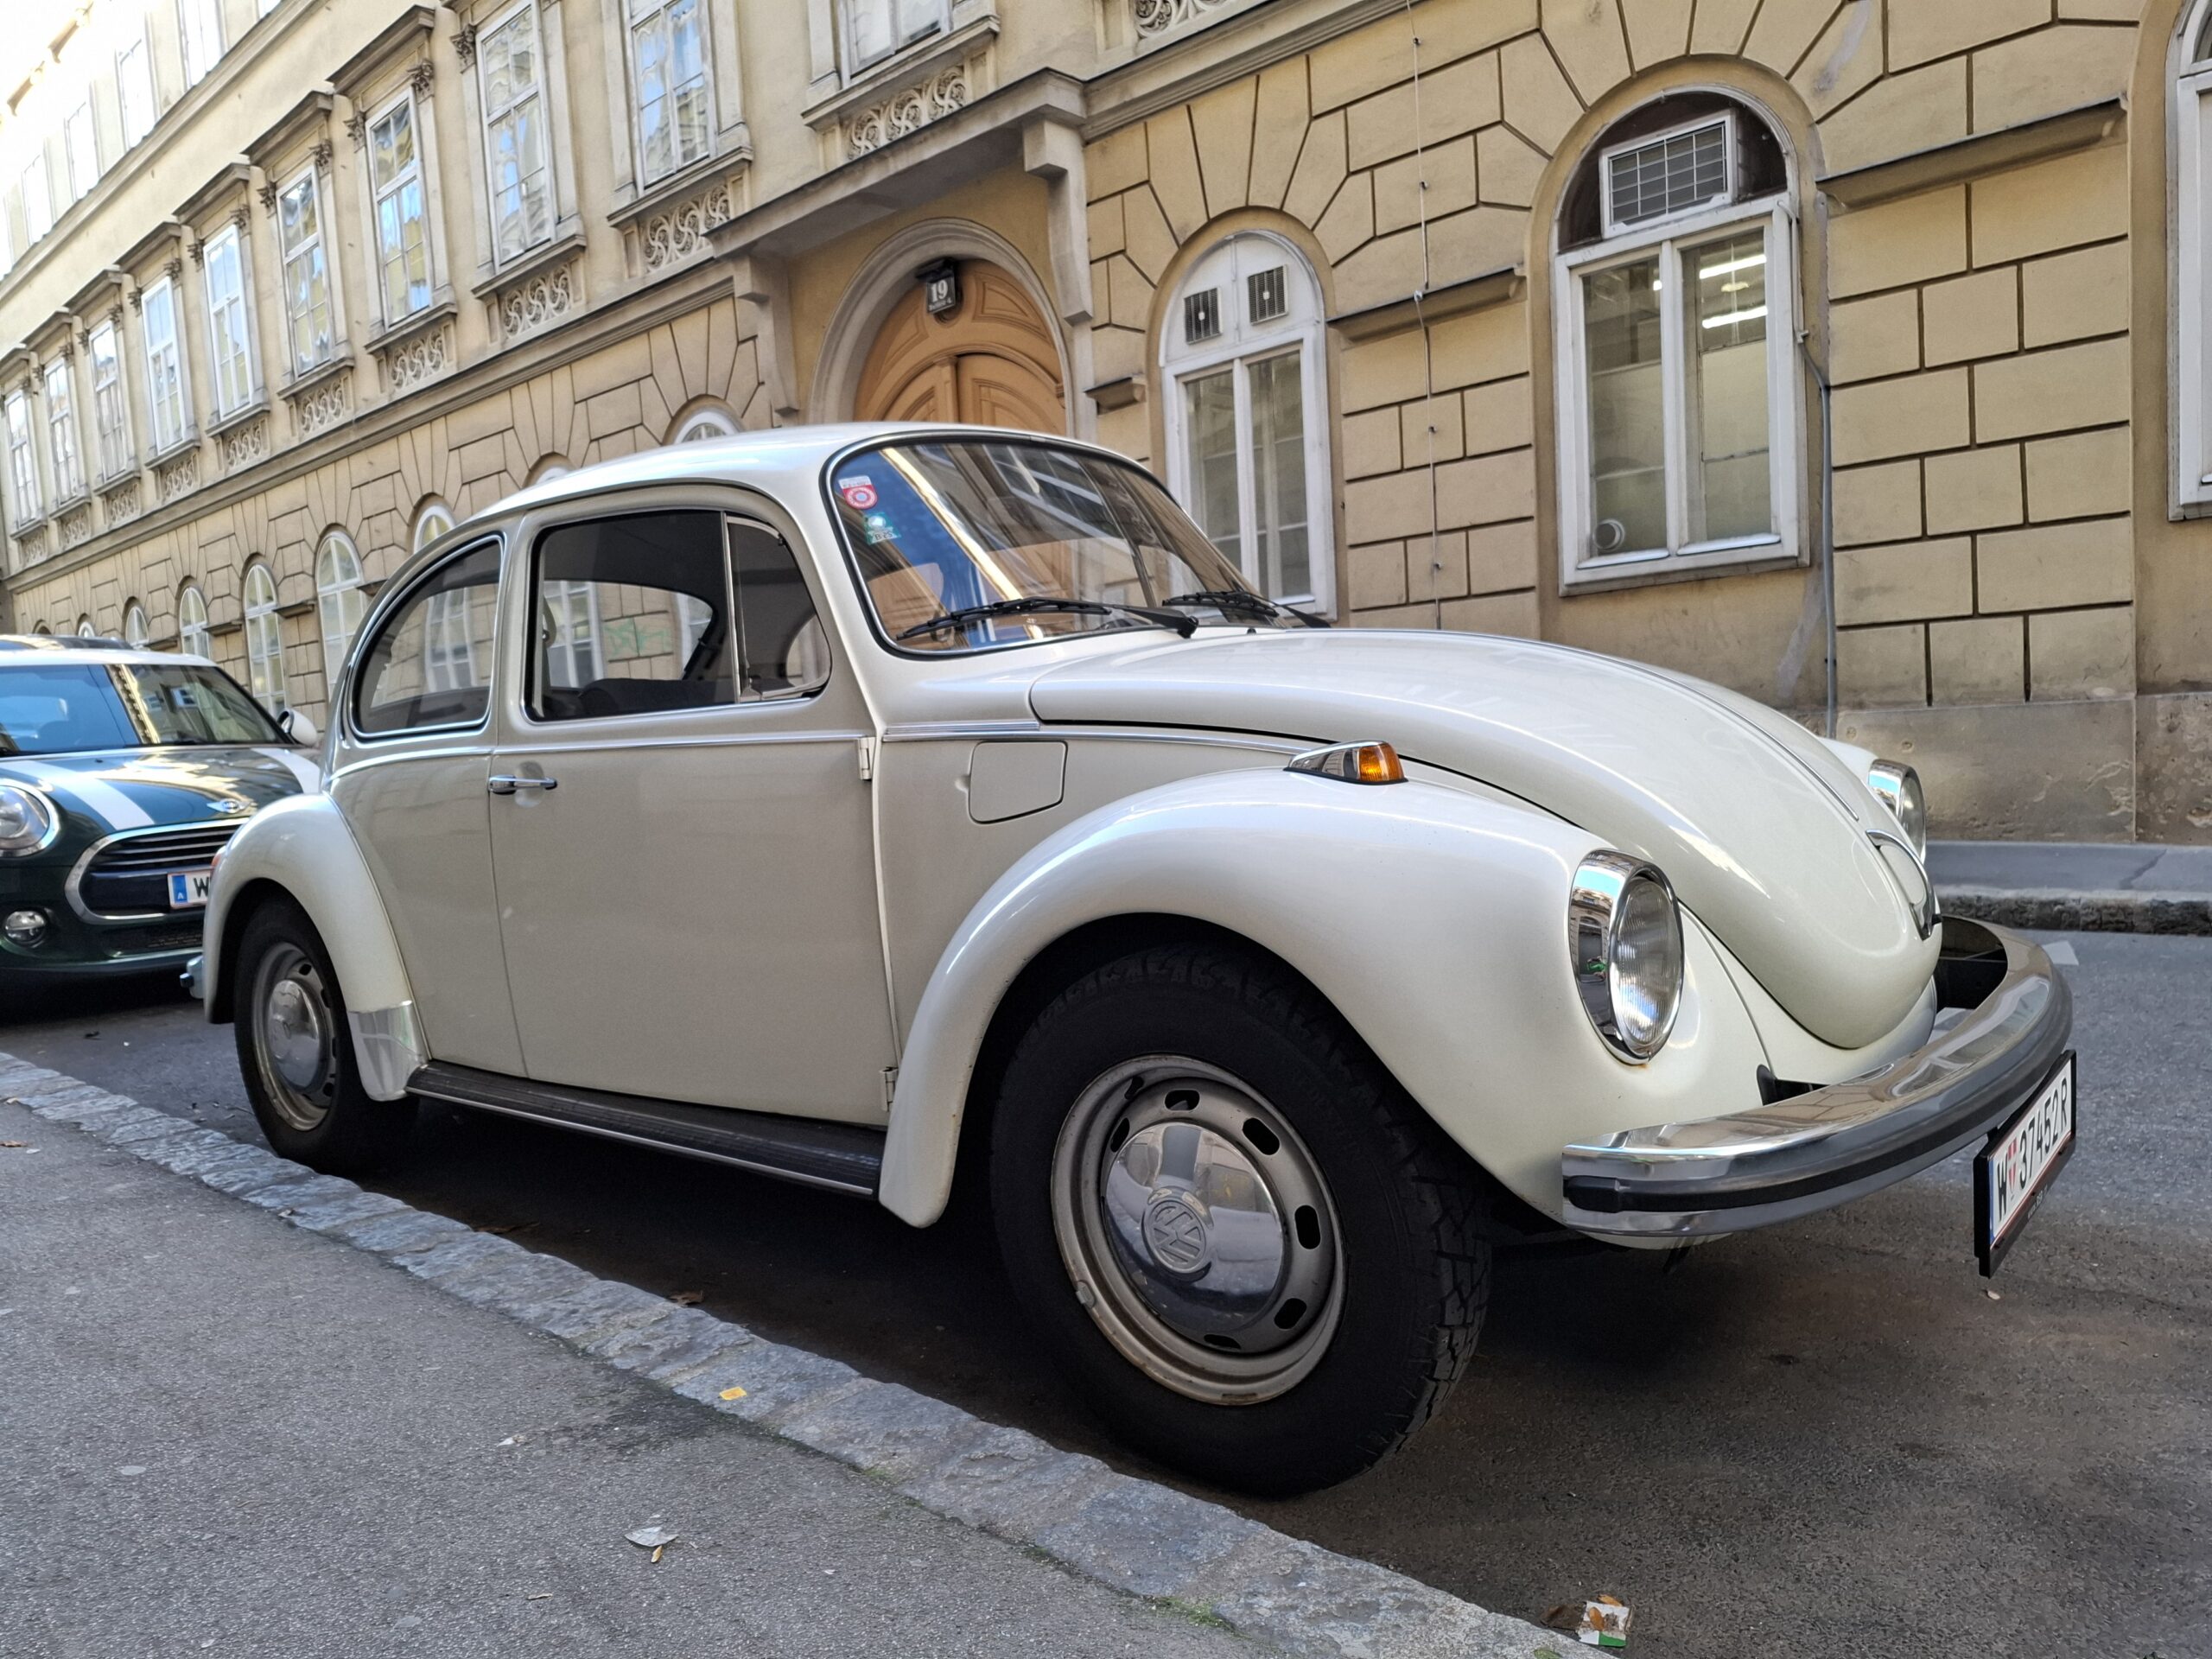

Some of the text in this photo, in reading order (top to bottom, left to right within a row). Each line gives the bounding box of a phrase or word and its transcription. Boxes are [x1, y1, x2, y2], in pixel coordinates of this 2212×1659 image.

[931, 279, 949, 302] 19
[177, 875, 209, 900] A W
[1997, 1149, 2008, 1222] W
[1147, 1199, 1206, 1273] VW
